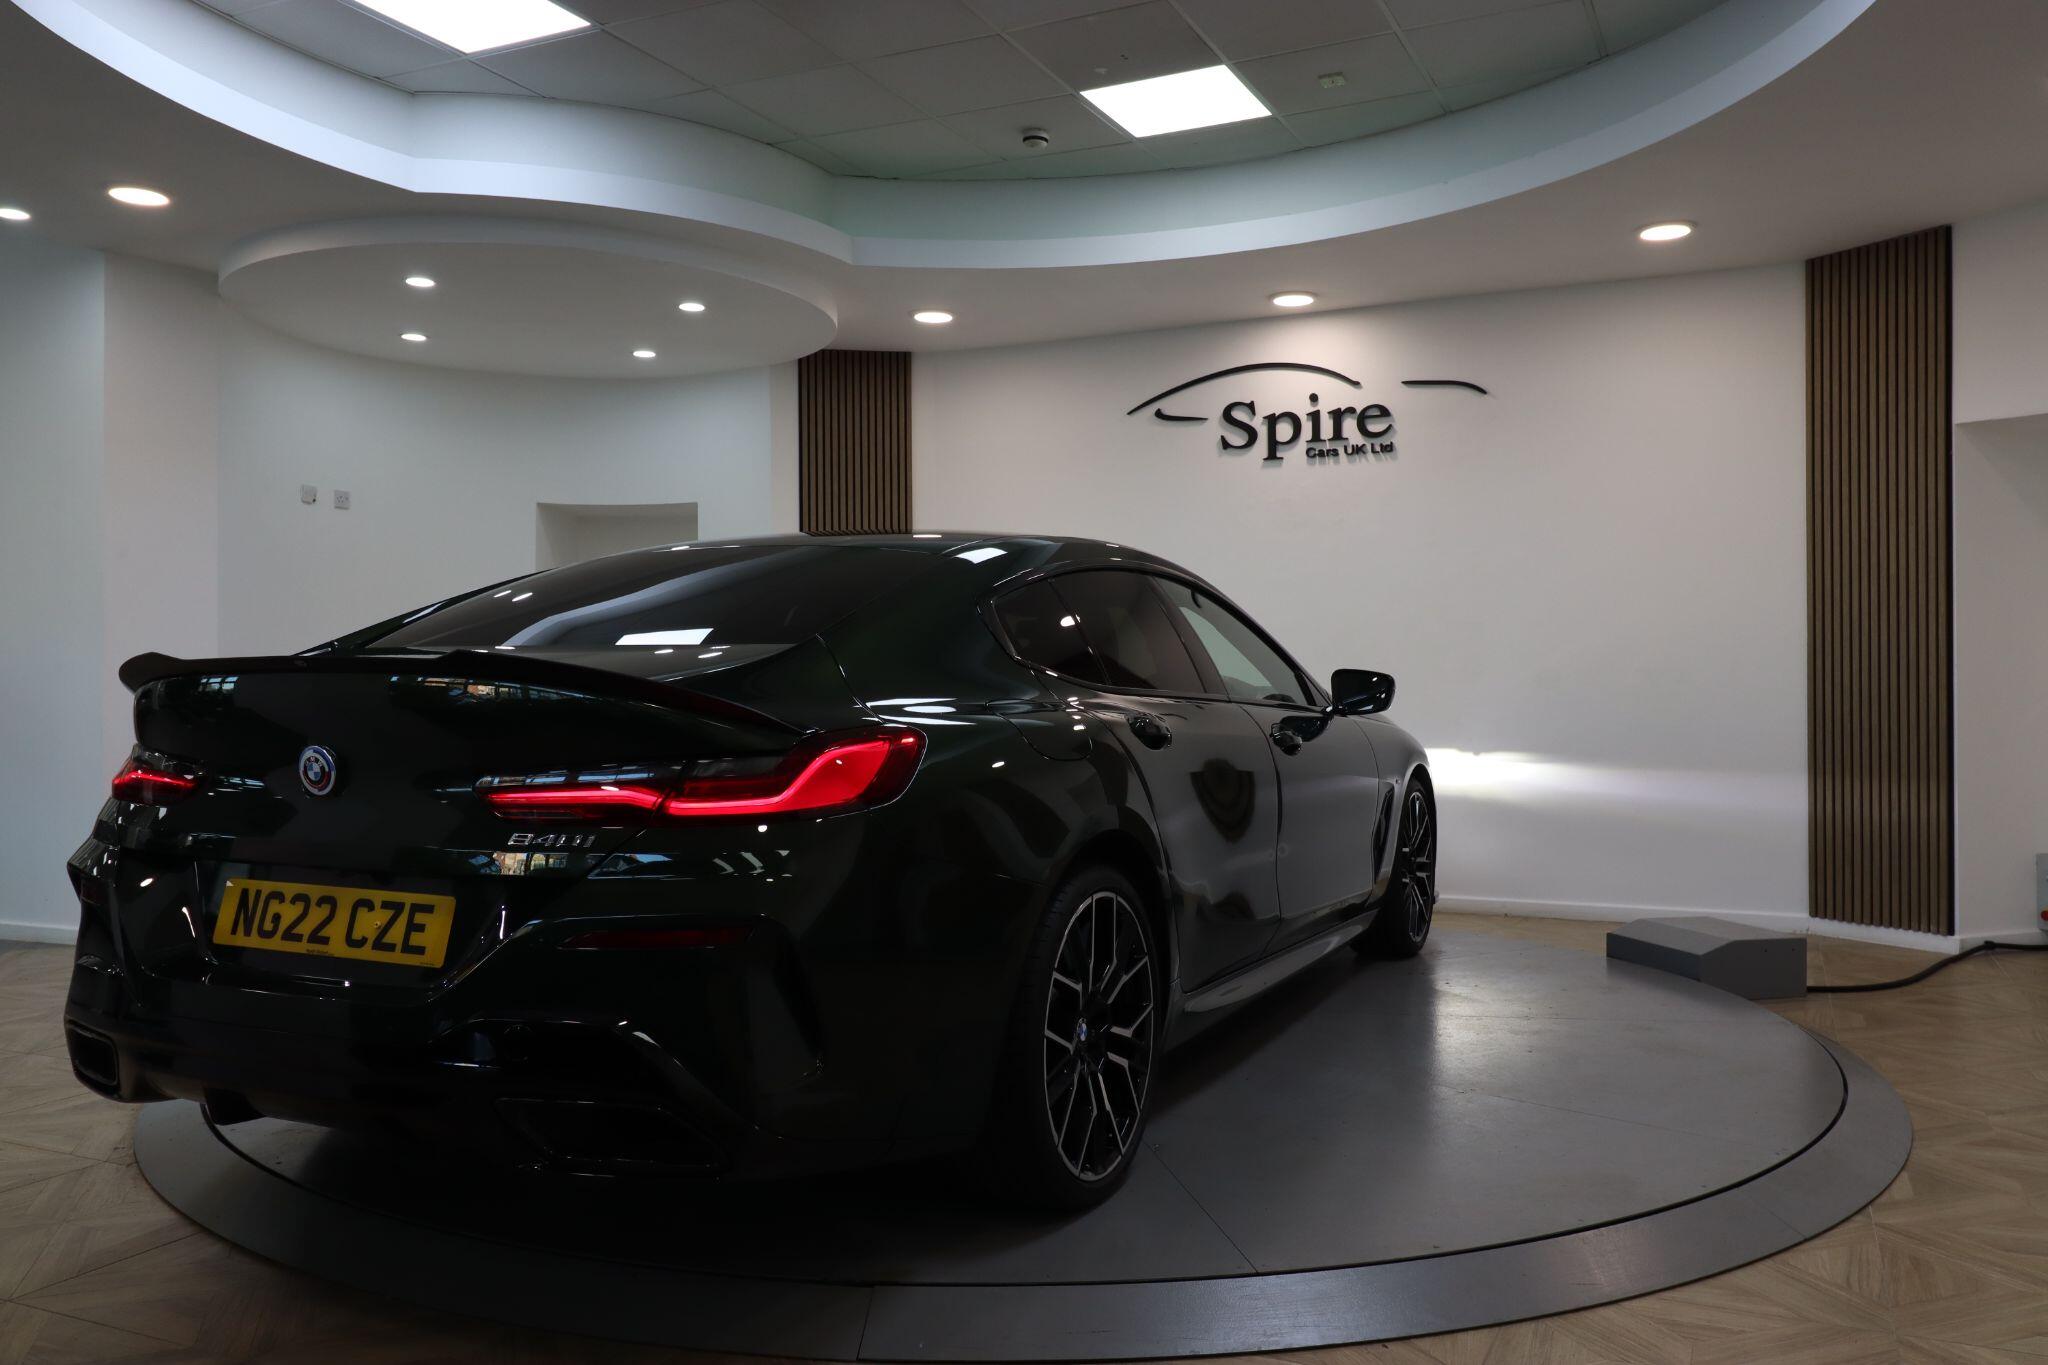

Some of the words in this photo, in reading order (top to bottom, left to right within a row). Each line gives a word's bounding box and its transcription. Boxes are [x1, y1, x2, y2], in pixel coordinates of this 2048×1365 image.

[1219, 392, 1394, 460] Spire
[1306, 447, 1340, 458] Cars
[1343, 444, 1367, 456] UK
[1371, 441, 1394, 454] Ltd
[230, 887, 338, 946] NG22
[345, 898, 436, 956] CZE
